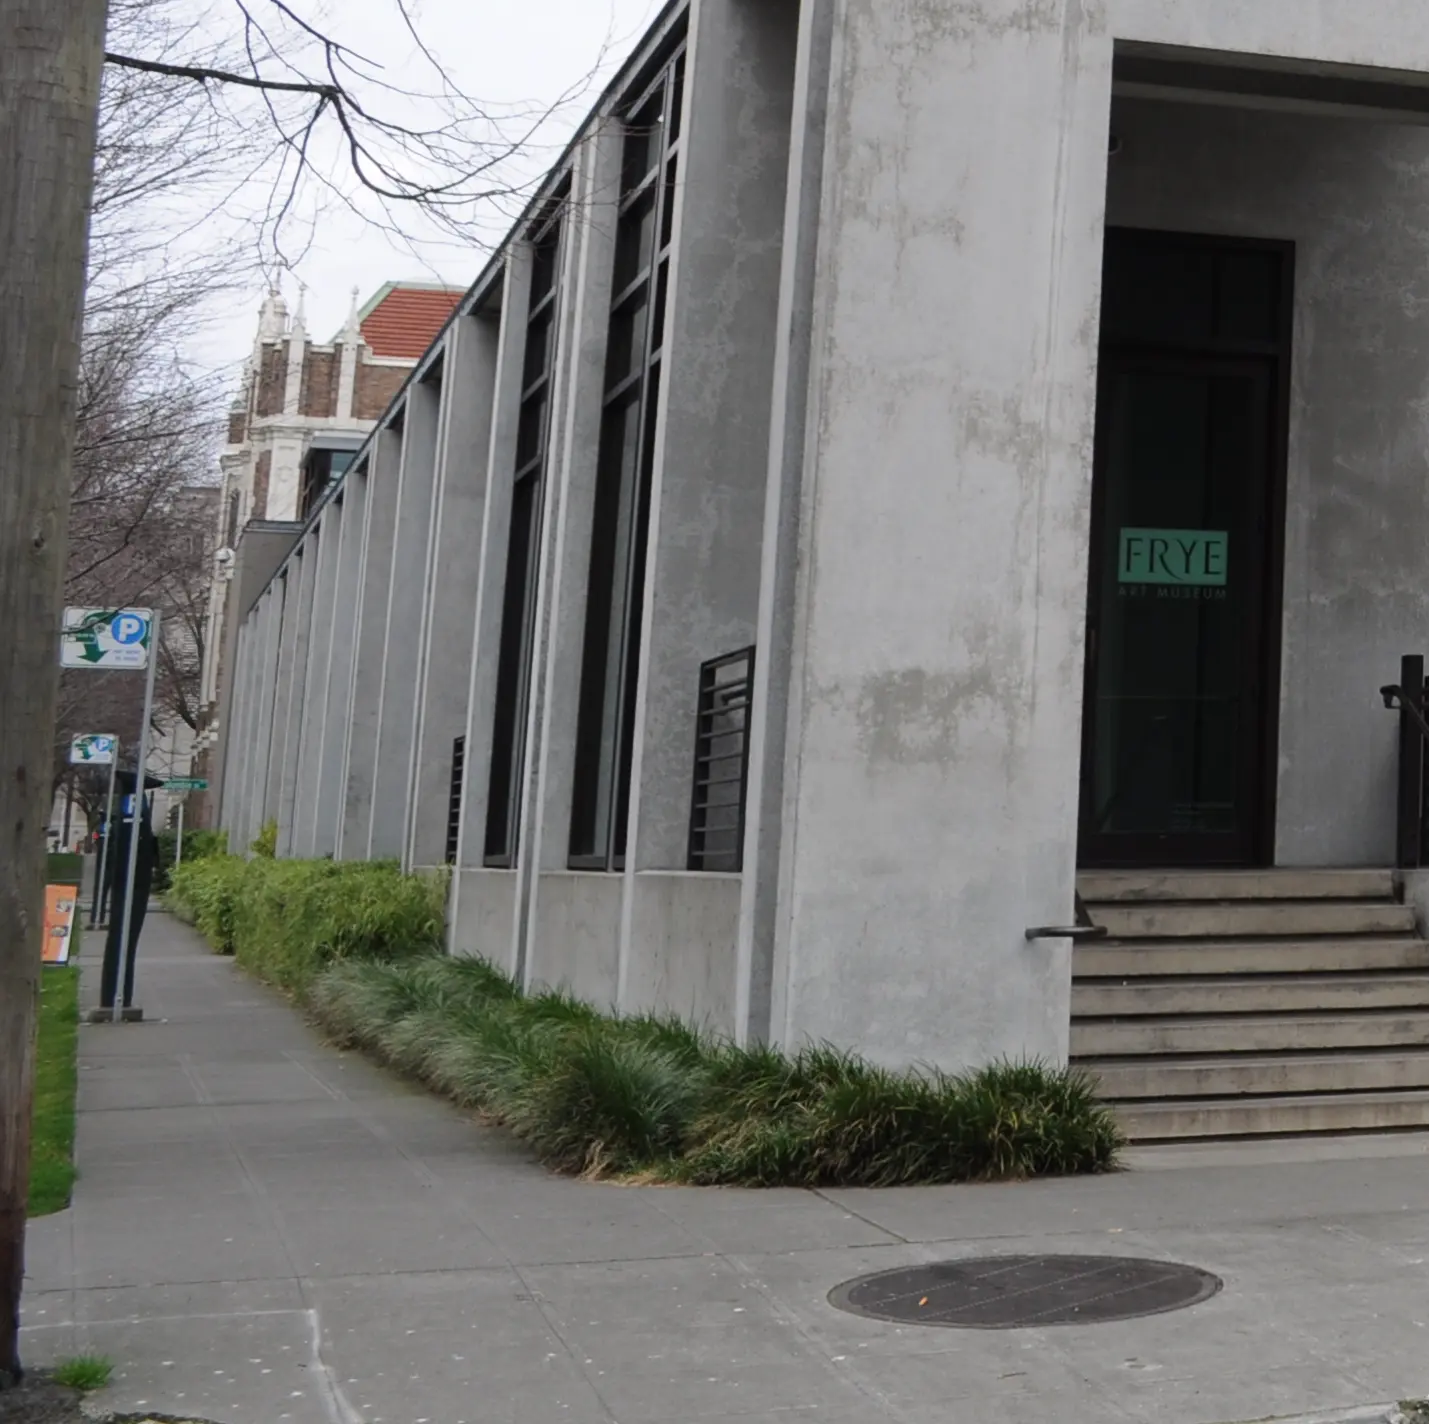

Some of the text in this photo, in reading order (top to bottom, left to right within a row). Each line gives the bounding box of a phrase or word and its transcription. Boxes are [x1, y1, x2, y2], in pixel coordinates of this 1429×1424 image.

[1125, 537, 1223, 580] FRYE
[1118, 586, 1227, 600] ART MUSEUM
[118, 618, 140, 642] P
